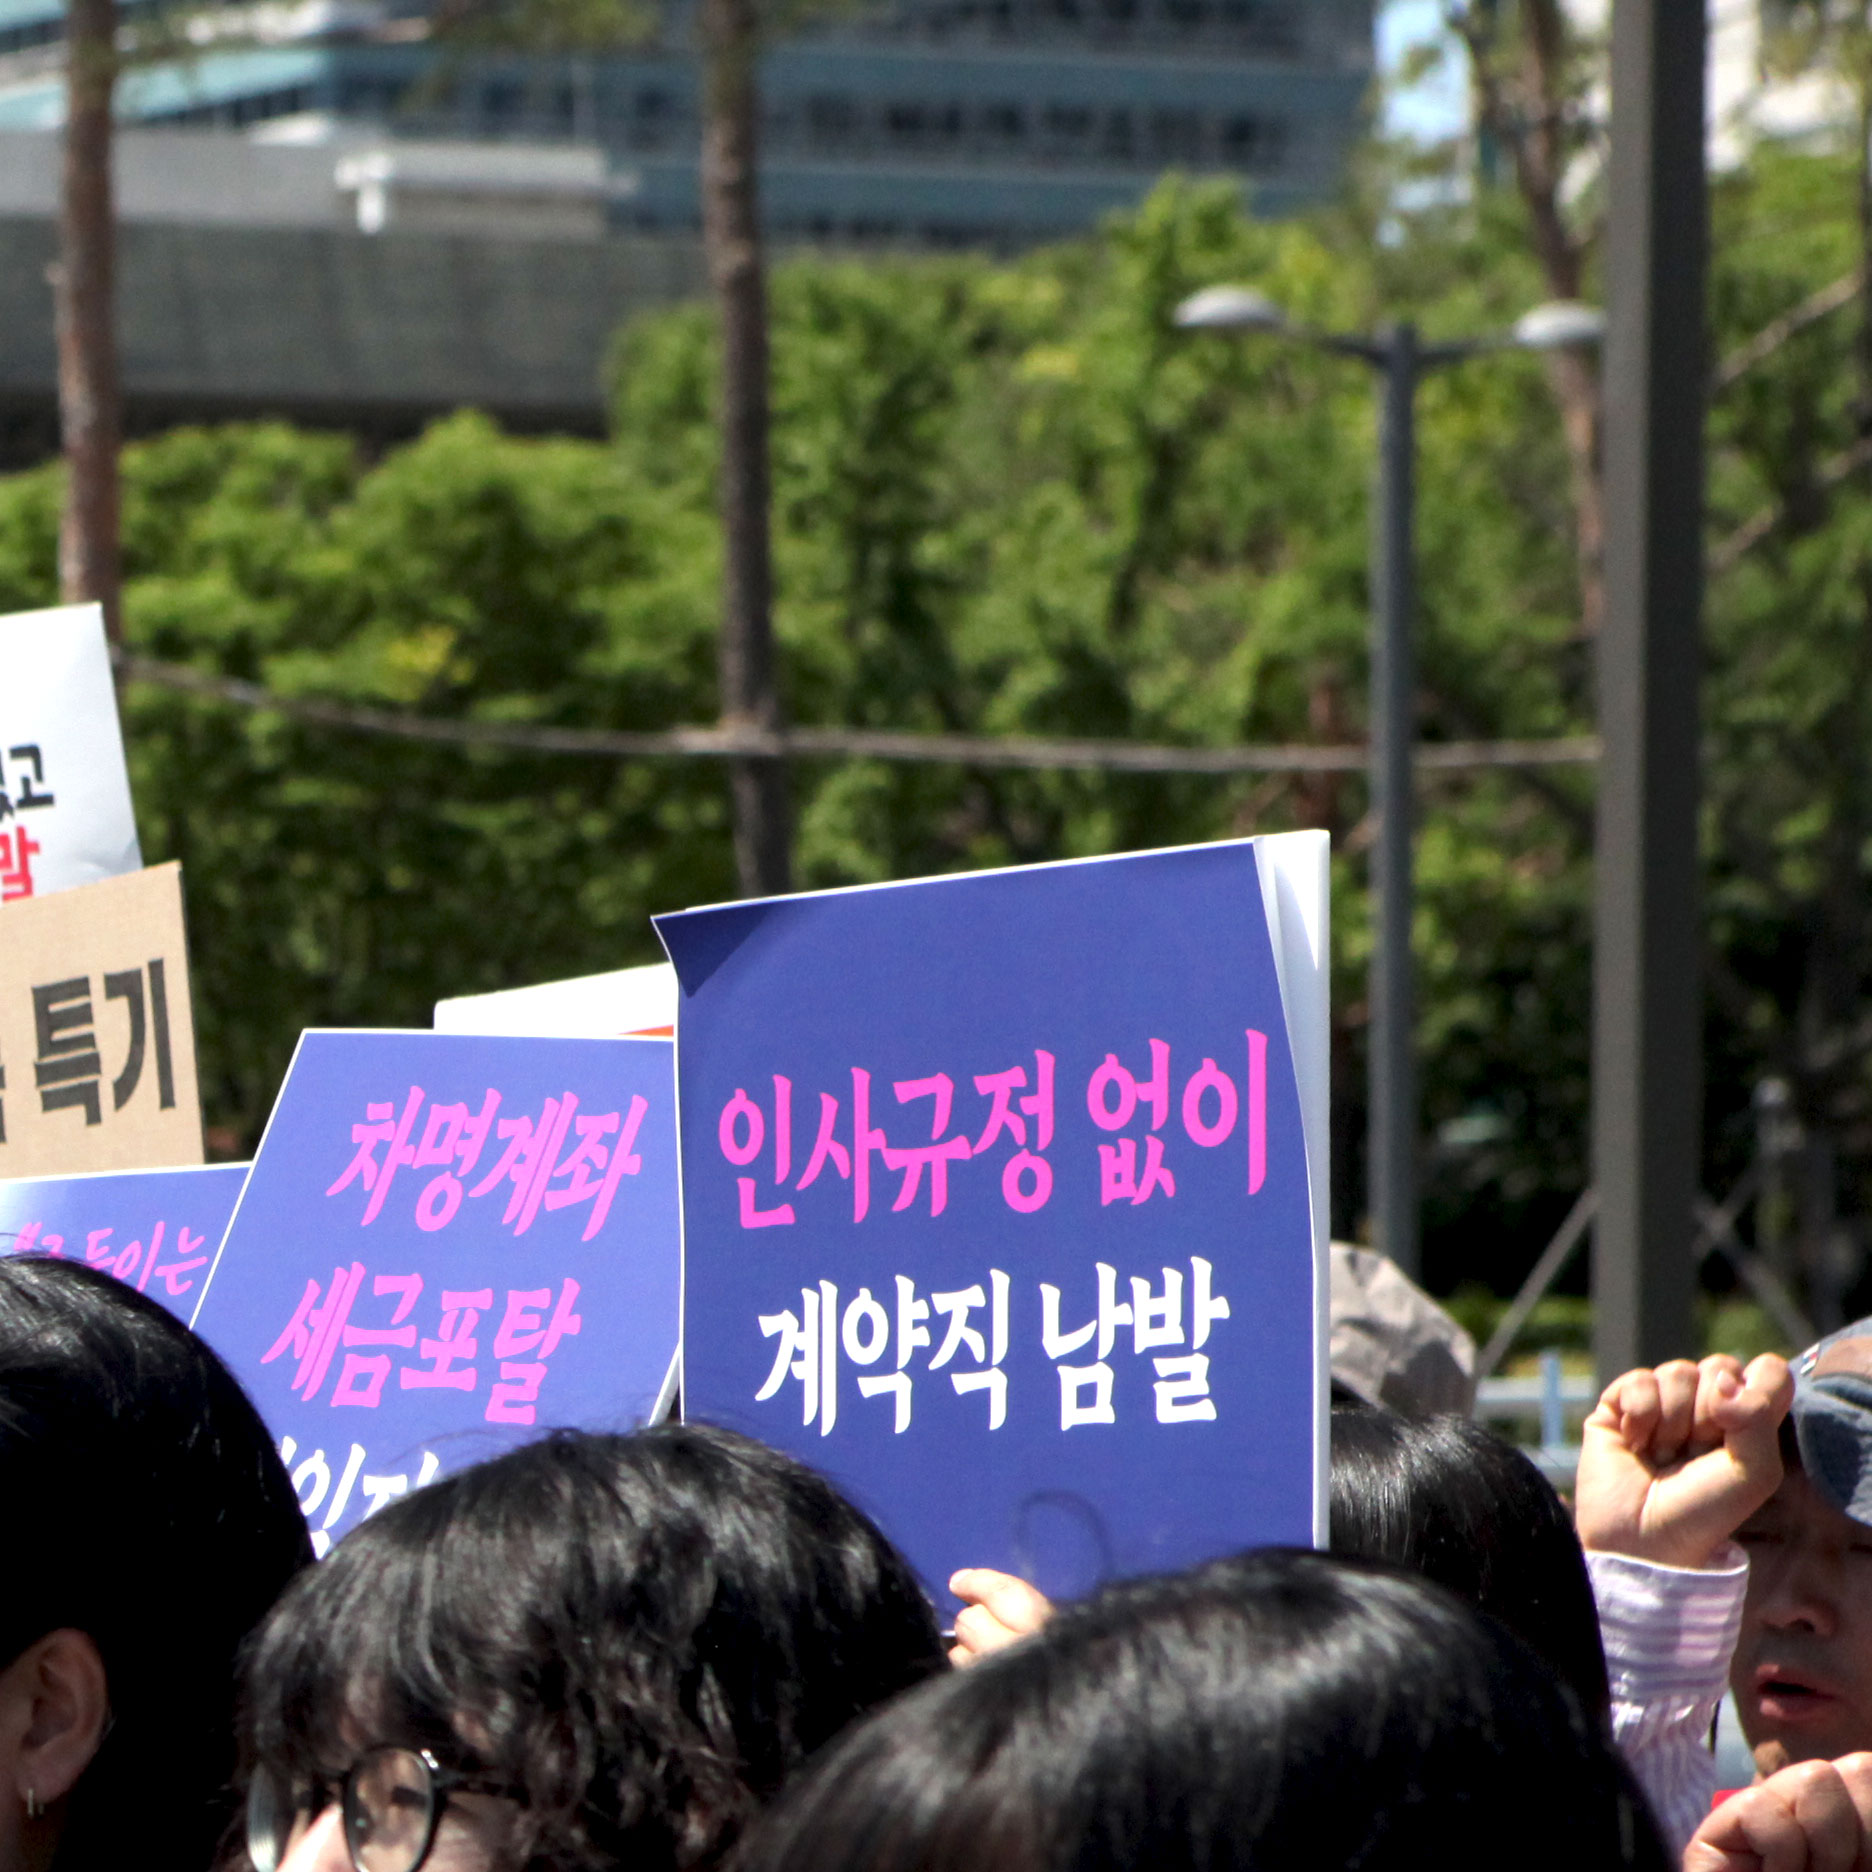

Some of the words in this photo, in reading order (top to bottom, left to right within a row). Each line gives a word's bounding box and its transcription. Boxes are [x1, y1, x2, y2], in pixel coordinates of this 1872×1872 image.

[31, 957, 176, 1127] 특기
[326, 1085, 649, 1242] 차명계좌
[718, 1048, 1057, 1230] 인사규정
[1087, 1028, 1268, 1206] 없이
[260, 1261, 582, 1425] 세금포탈
[755, 1268, 1011, 1437] 계약직
[1039, 1256, 1230, 1431] 남발
